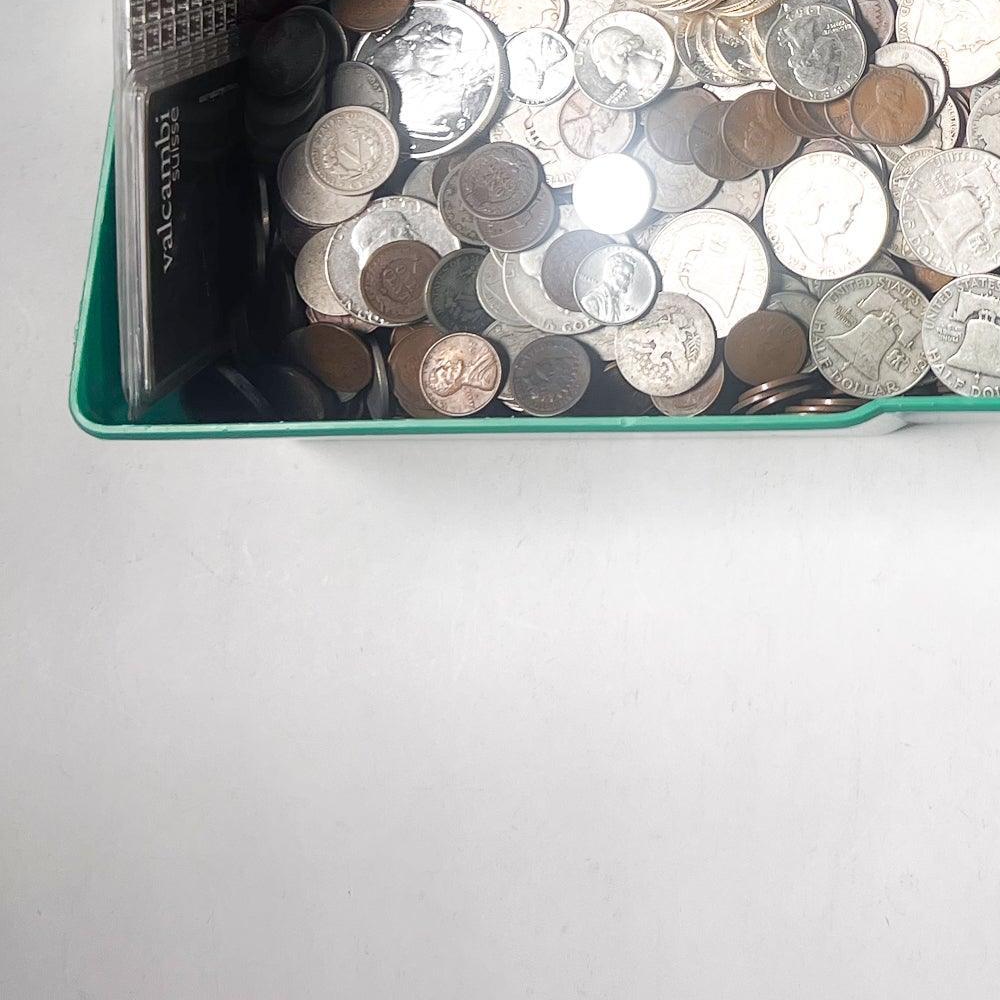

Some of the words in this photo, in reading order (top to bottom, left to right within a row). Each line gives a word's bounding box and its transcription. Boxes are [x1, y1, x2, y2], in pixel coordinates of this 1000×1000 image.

[170, 106, 180, 181] suisse
[154, 112, 174, 274] valcambi
[827, 277, 873, 303] UNITED
[877, 277, 922, 308] STATES
[924, 287, 953, 330] UNITED
[811, 319, 834, 369] HALF
[831, 368, 900, 397] DOLLAR
[926, 346, 967, 390] HALF
